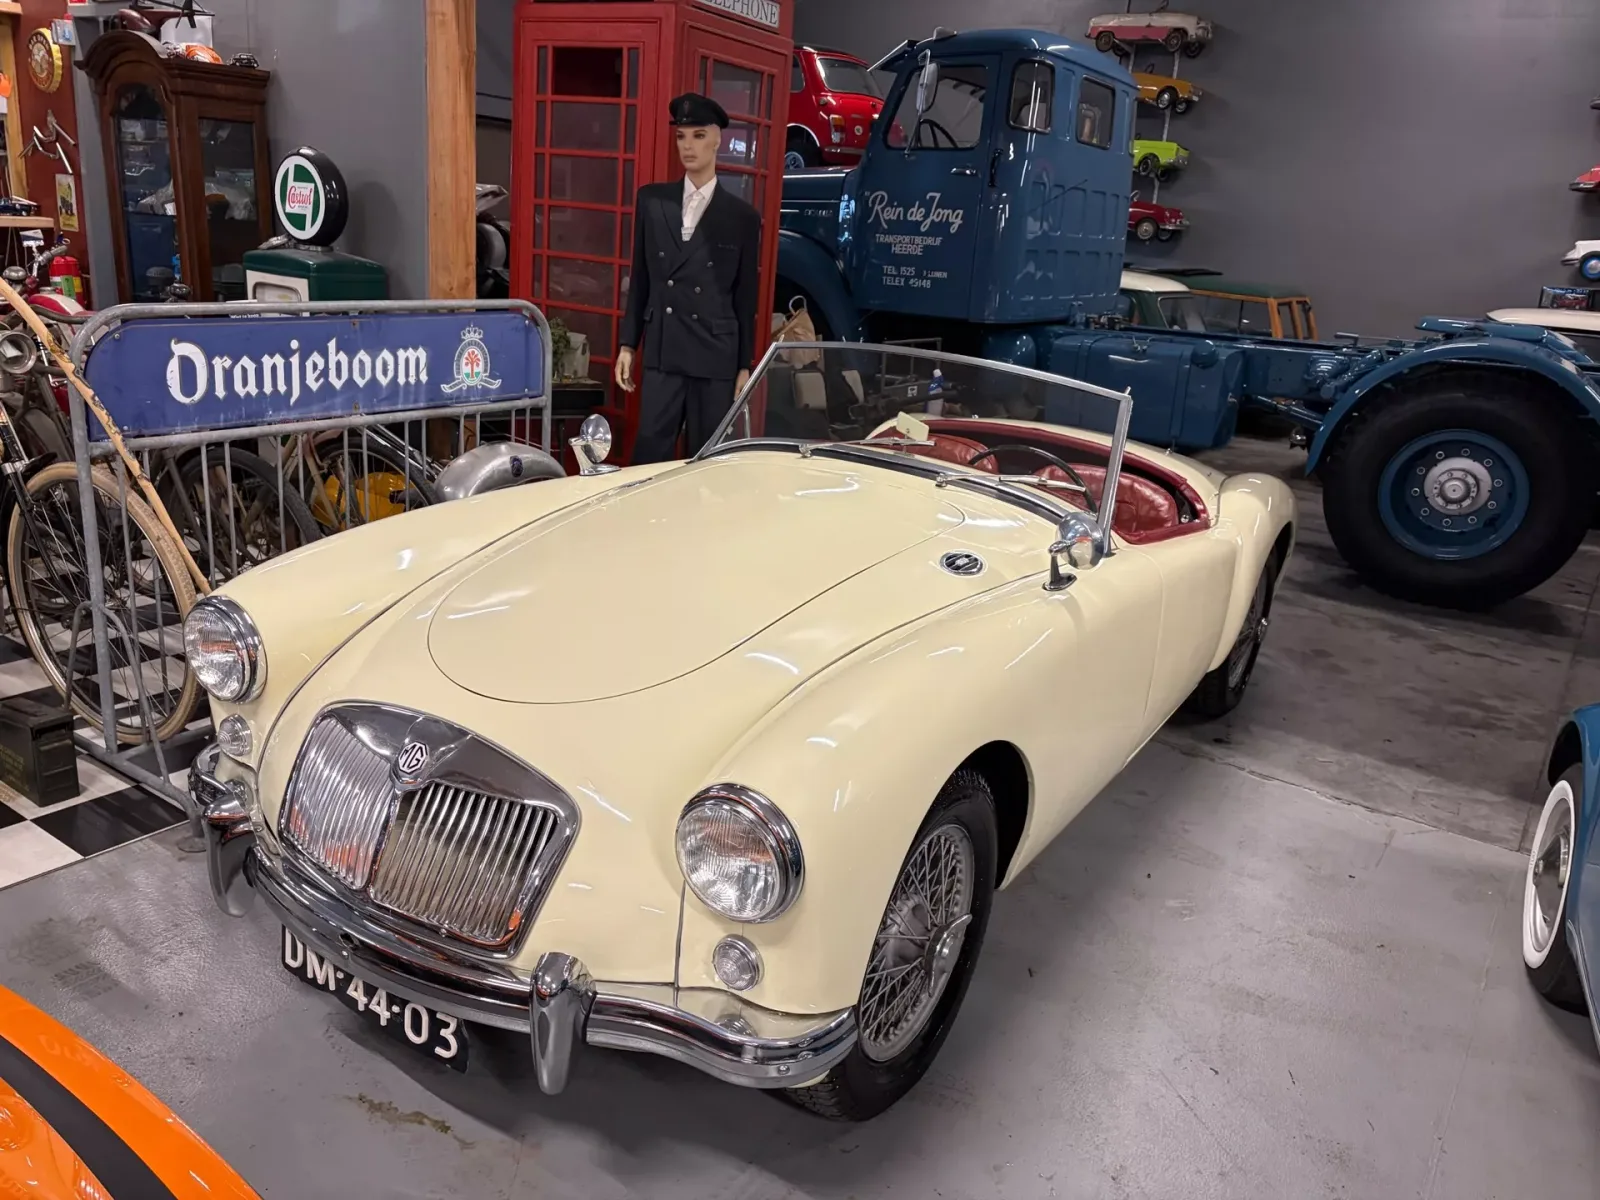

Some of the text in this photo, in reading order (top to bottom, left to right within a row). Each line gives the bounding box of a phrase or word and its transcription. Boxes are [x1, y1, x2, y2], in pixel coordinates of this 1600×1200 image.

[288, 186, 313, 209] Castrol
[867, 191, 964, 233] Rein de Jong
[891, 243, 923, 255] HEERDE
[882, 276, 905, 286] TELEX
[900, 266, 916, 276] 1525
[166, 338, 428, 405] Oranjeboom
[400, 744, 424, 769] MG
